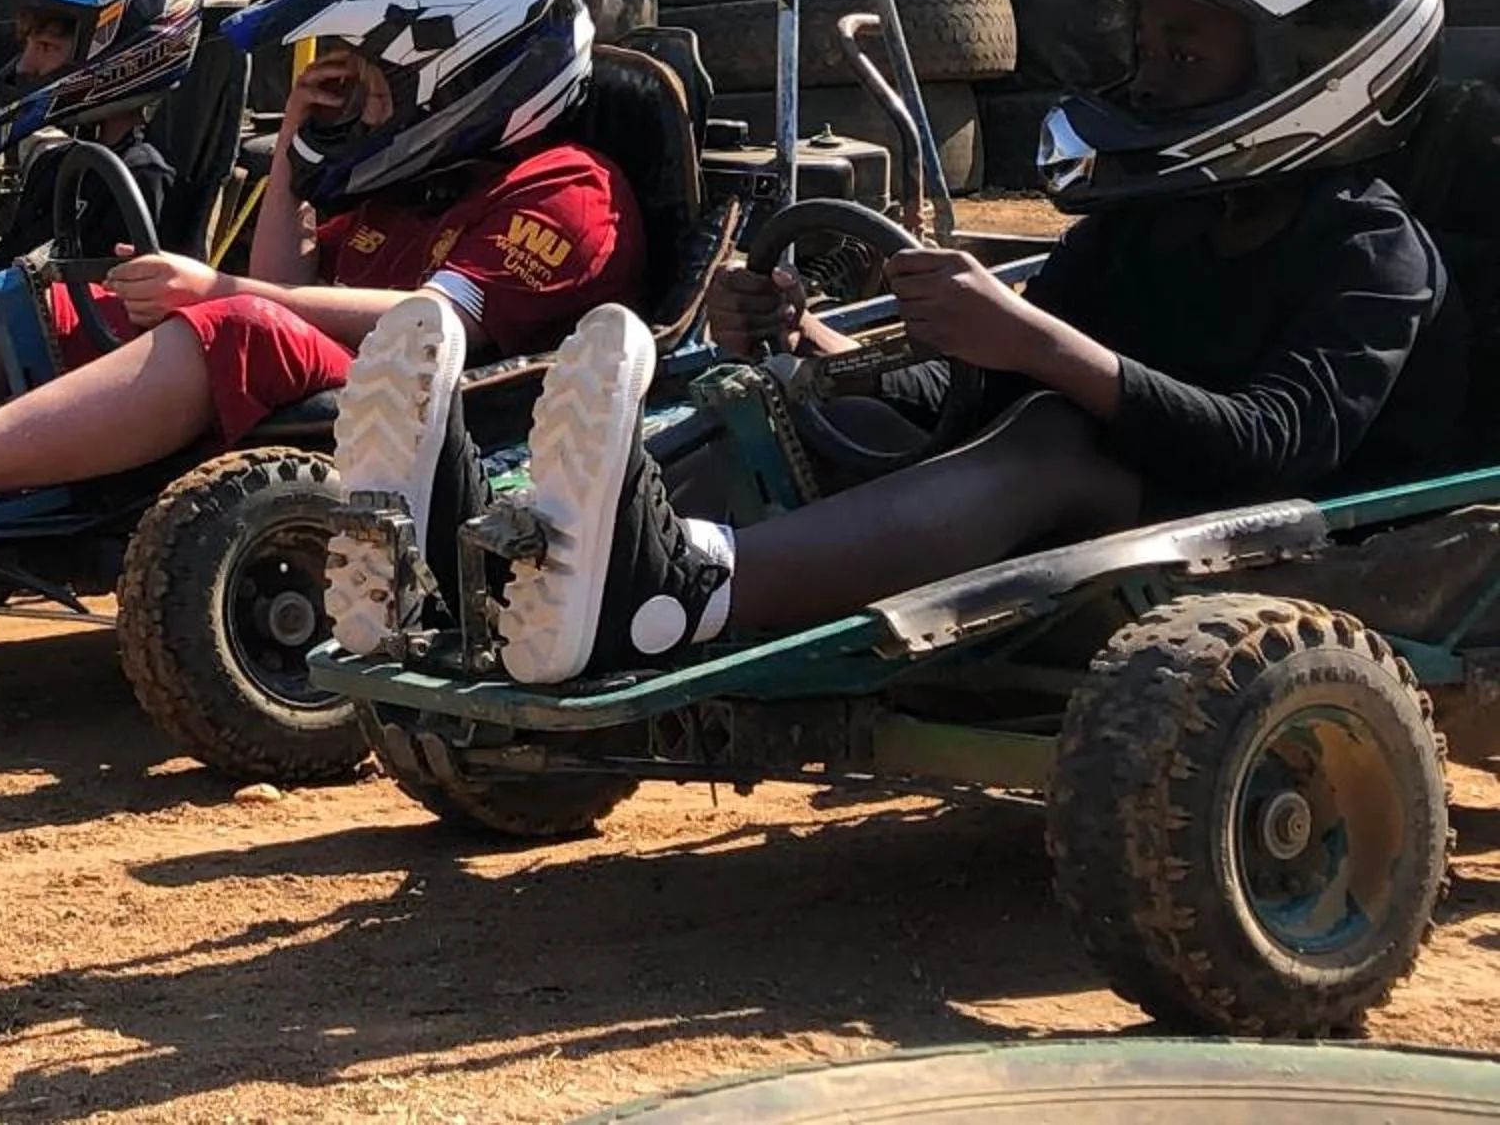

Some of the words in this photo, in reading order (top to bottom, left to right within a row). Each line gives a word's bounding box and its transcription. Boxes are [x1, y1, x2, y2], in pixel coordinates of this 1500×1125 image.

[492, 235, 553, 282] Western
[508, 215, 572, 267] WU
[504, 253, 543, 291] Union
